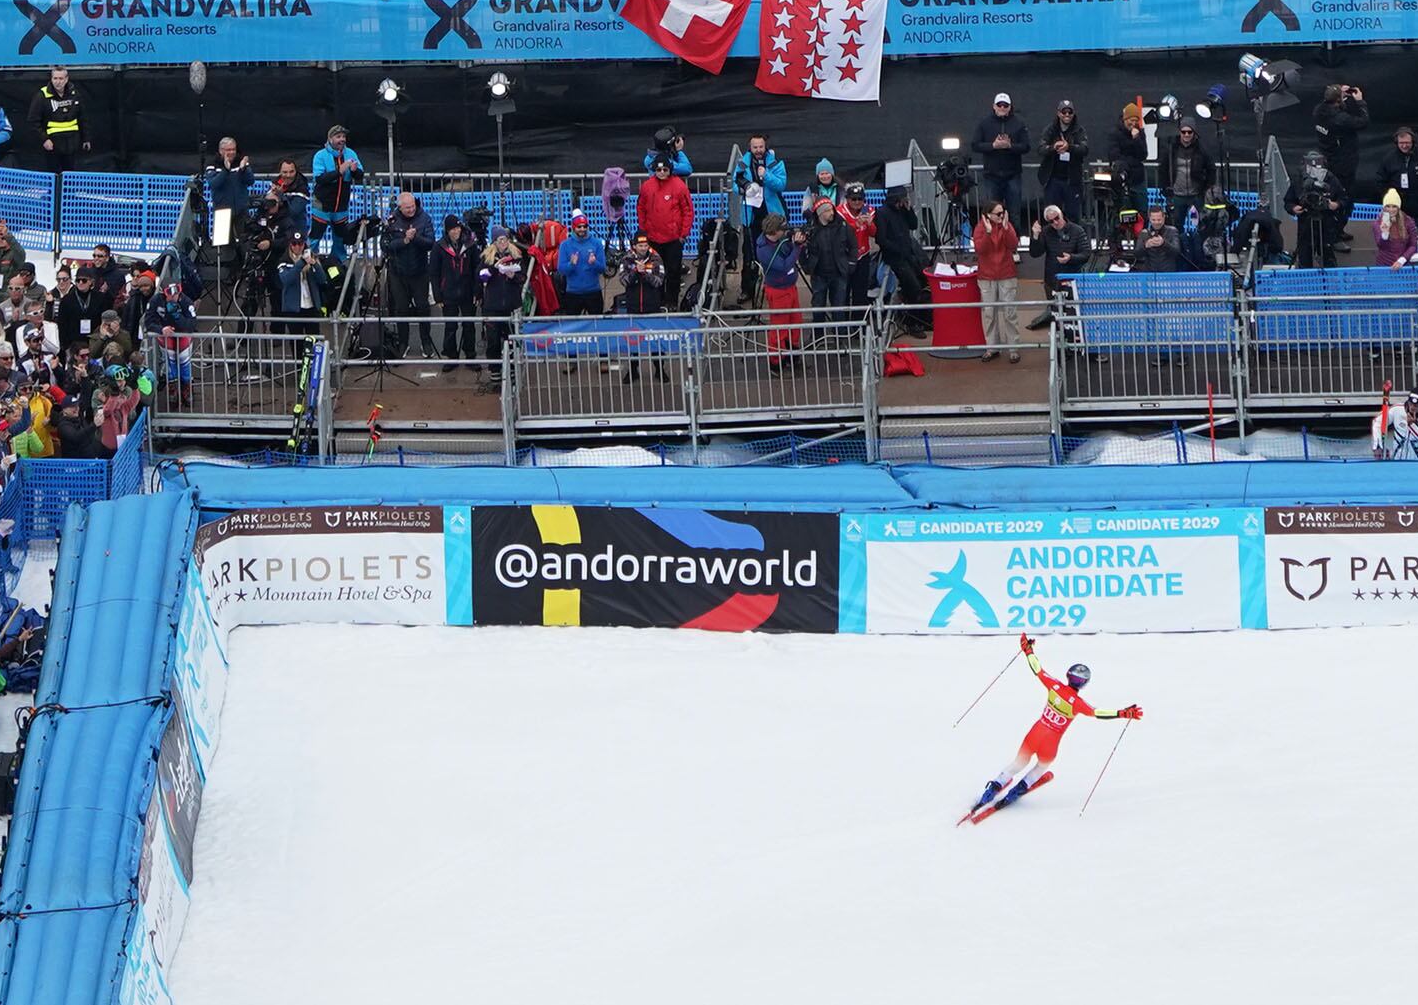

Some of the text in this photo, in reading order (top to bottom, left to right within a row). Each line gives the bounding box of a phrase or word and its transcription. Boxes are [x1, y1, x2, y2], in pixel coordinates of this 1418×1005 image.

[1311, 0, 1390, 13] Grandvalira
[492, 18, 624, 33] Grandvalira Resorts
[901, 11, 1034, 27] Grandvalira Resorts
[1312, 16, 1383, 31] ANDORRA
[86, 23, 217, 37] Grandvalira Resorts
[903, 30, 972, 44] ANDORRA
[88, 41, 156, 55] ANDORRA
[494, 36, 564, 50] ANDORRA
[231, 512, 312, 525] PARKPIOLETS
[346, 511, 431, 521] PARKPIOLETS
[1299, 511, 1385, 522] PARKPIOLETS
[920, 521, 1003, 535] CANDIDATE
[1006, 520, 1043, 534] 2029
[1096, 517, 1179, 532] CANDIDATE
[1183, 516, 1220, 530] 2029
[1006, 545, 1160, 571] ANDORRA
[209, 555, 432, 589] ARKPIOLETS
[494, 543, 817, 589] @andorraworld
[1006, 572, 1183, 599] CANDIDATE
[252, 585, 432, 603] Mountain Hotel &Spa
[1006, 604, 1087, 628] 2029
